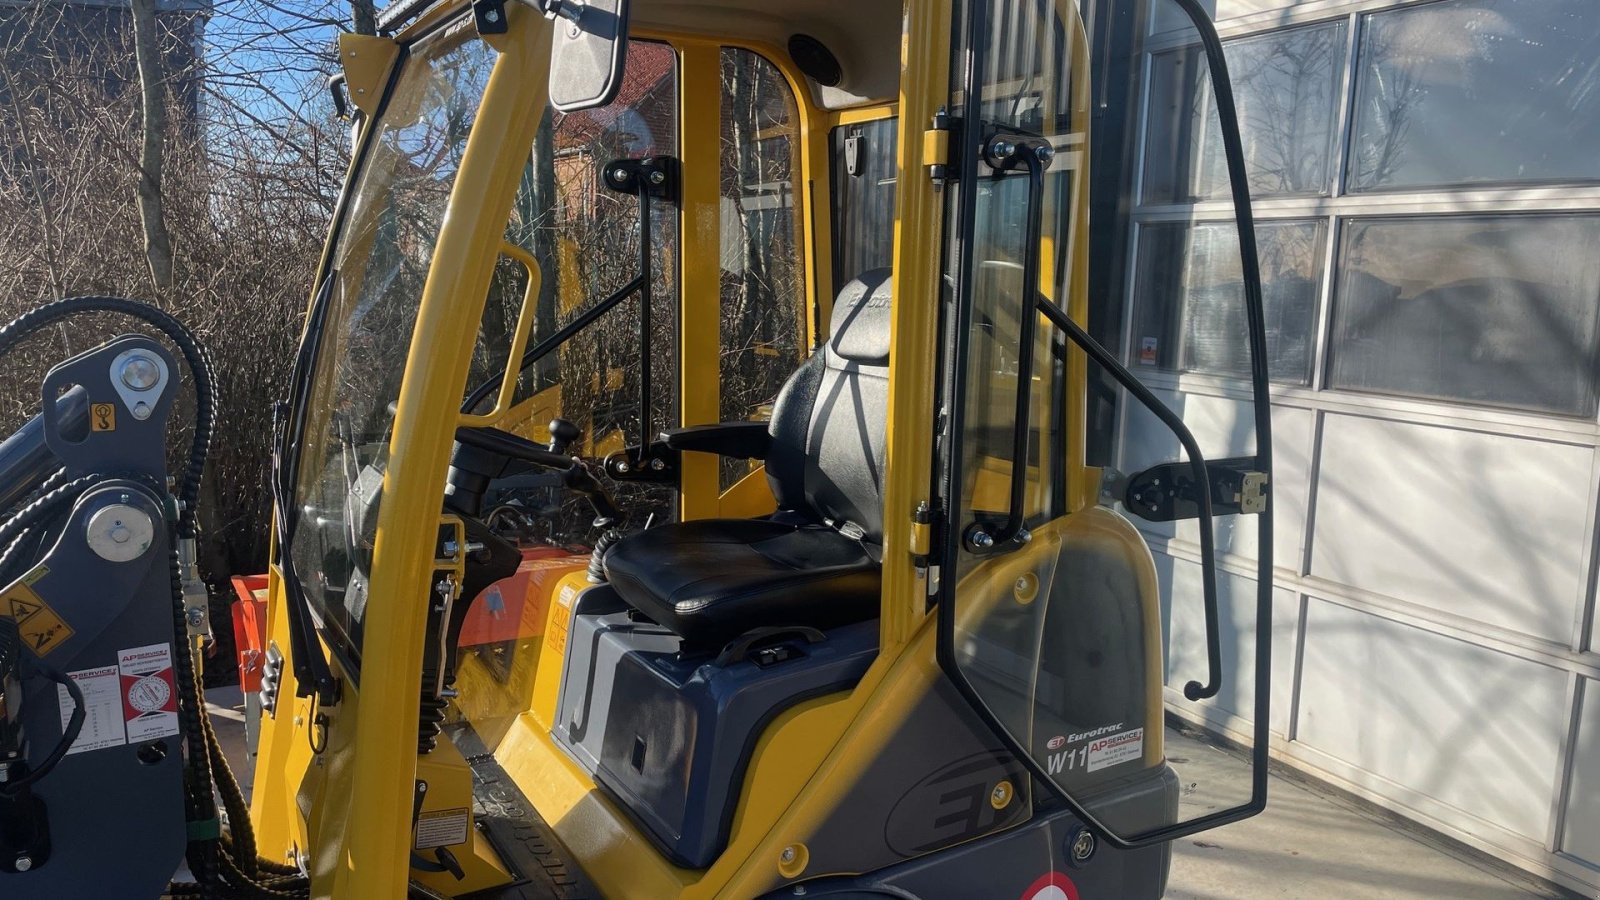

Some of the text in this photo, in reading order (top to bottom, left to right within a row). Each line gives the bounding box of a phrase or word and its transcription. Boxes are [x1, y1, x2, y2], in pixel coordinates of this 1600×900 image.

[79, 668, 114, 678] SERVICE
[1067, 722, 1123, 743] Eurotrac
[1090, 740, 1107, 754] AP
[1107, 731, 1138, 745] SERVICE
[1047, 745, 1087, 775] W11
